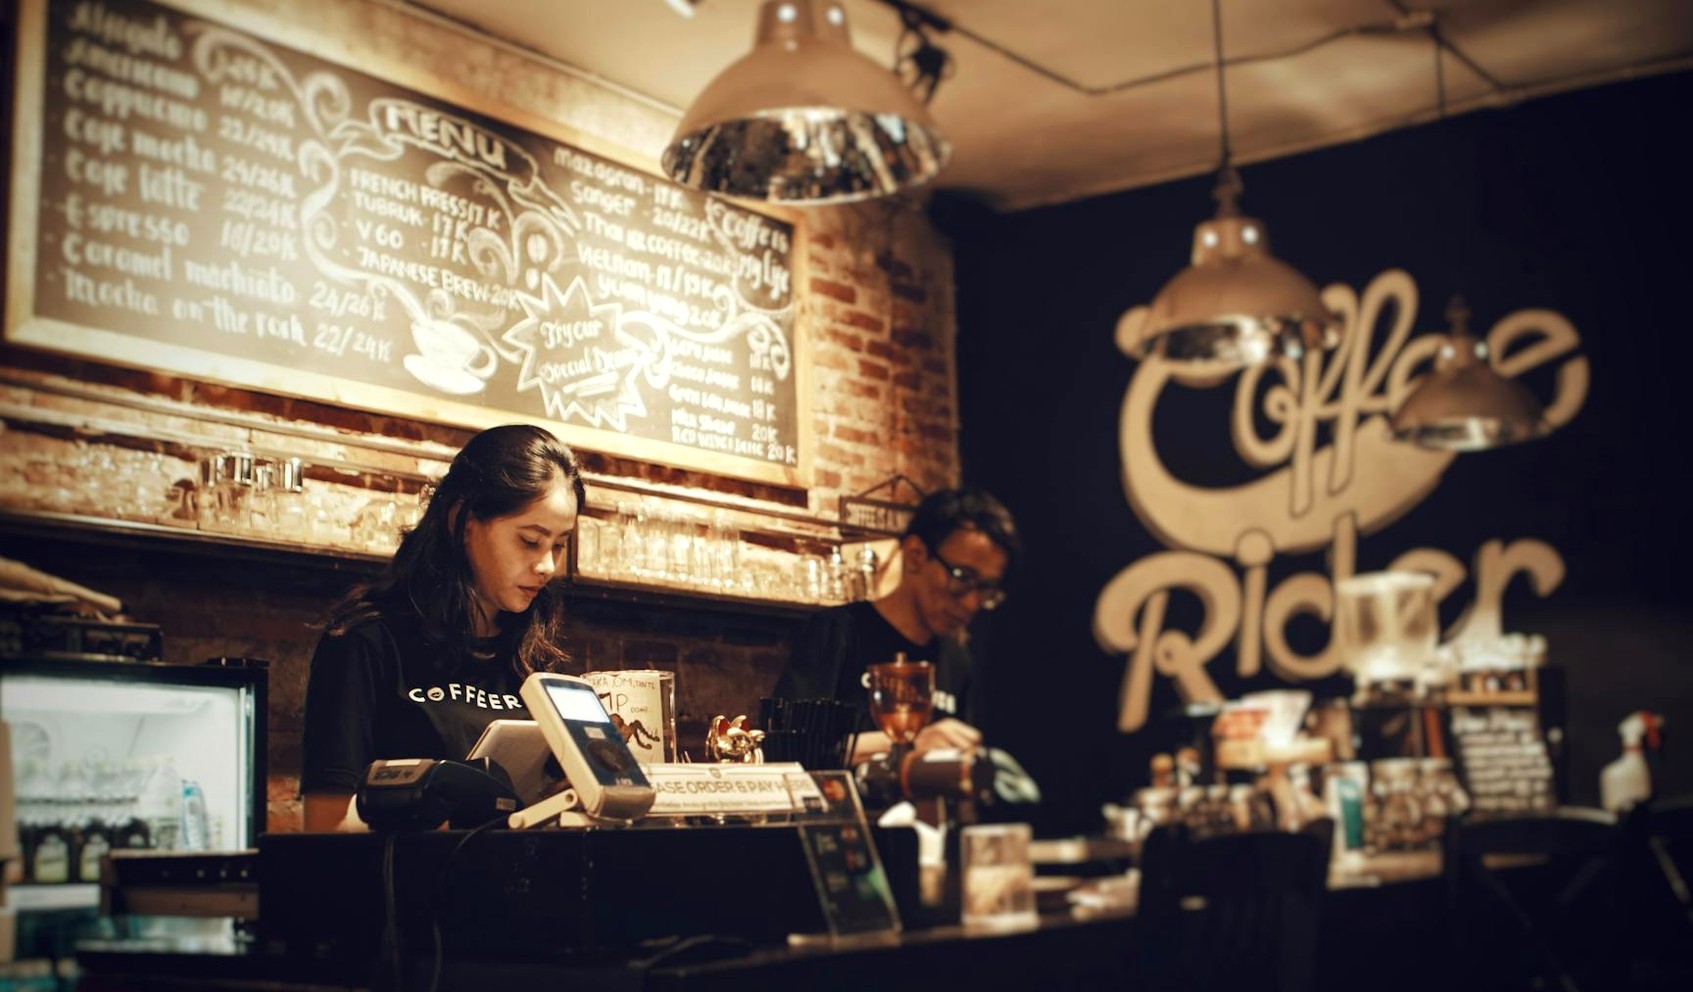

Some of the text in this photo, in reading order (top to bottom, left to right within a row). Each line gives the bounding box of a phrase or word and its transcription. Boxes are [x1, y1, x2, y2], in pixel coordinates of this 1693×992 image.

[385, 104, 507, 170] MENU
[350, 166, 417, 201] FRENCH
[356, 246, 440, 288] JAPANESE
[407, 682, 523, 711] COFFEER
[685, 780, 738, 795] ORDER
[749, 780, 778, 793] PAY
